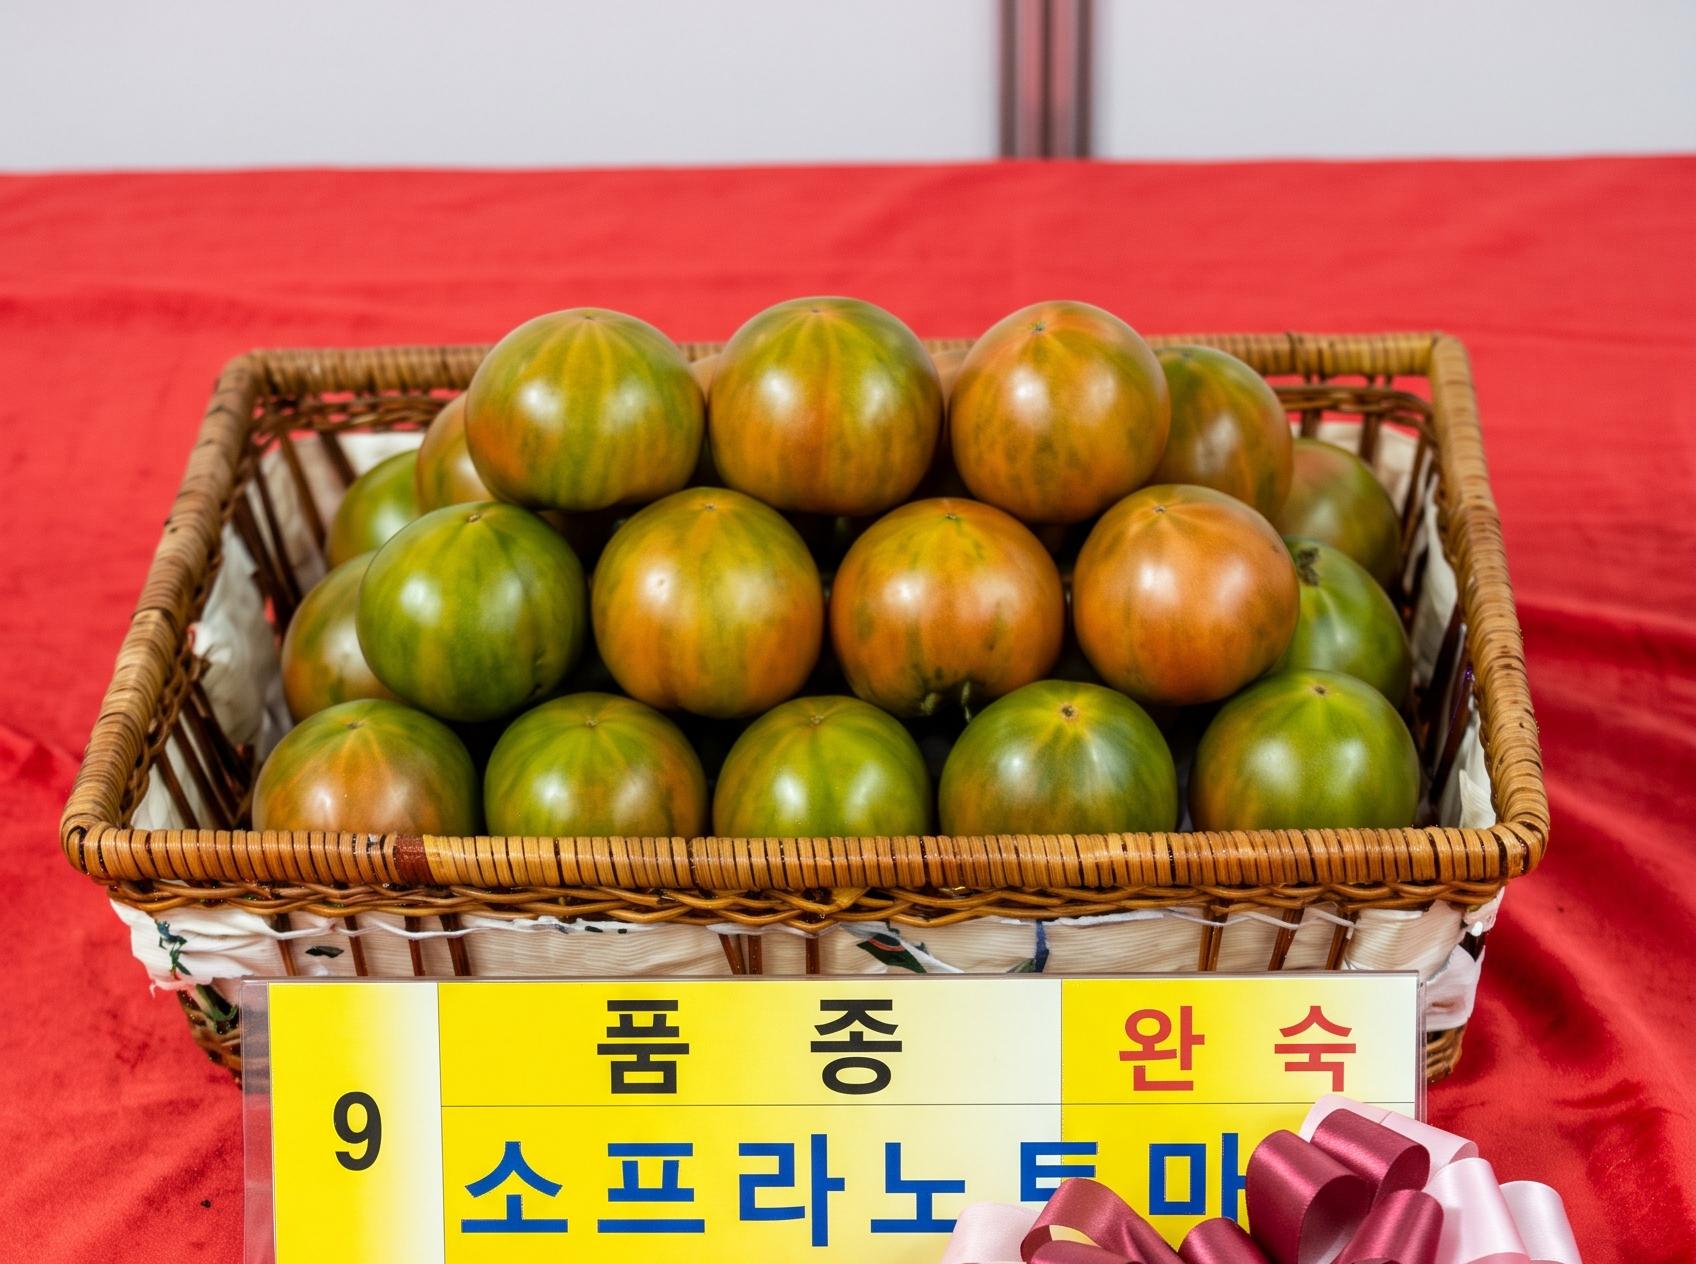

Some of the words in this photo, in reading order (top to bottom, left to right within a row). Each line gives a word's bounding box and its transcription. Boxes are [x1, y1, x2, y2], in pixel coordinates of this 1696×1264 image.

[597, 999, 902, 1096] 품종
[1118, 1005, 1357, 1093] 완숙
[332, 1091, 383, 1171] 9
